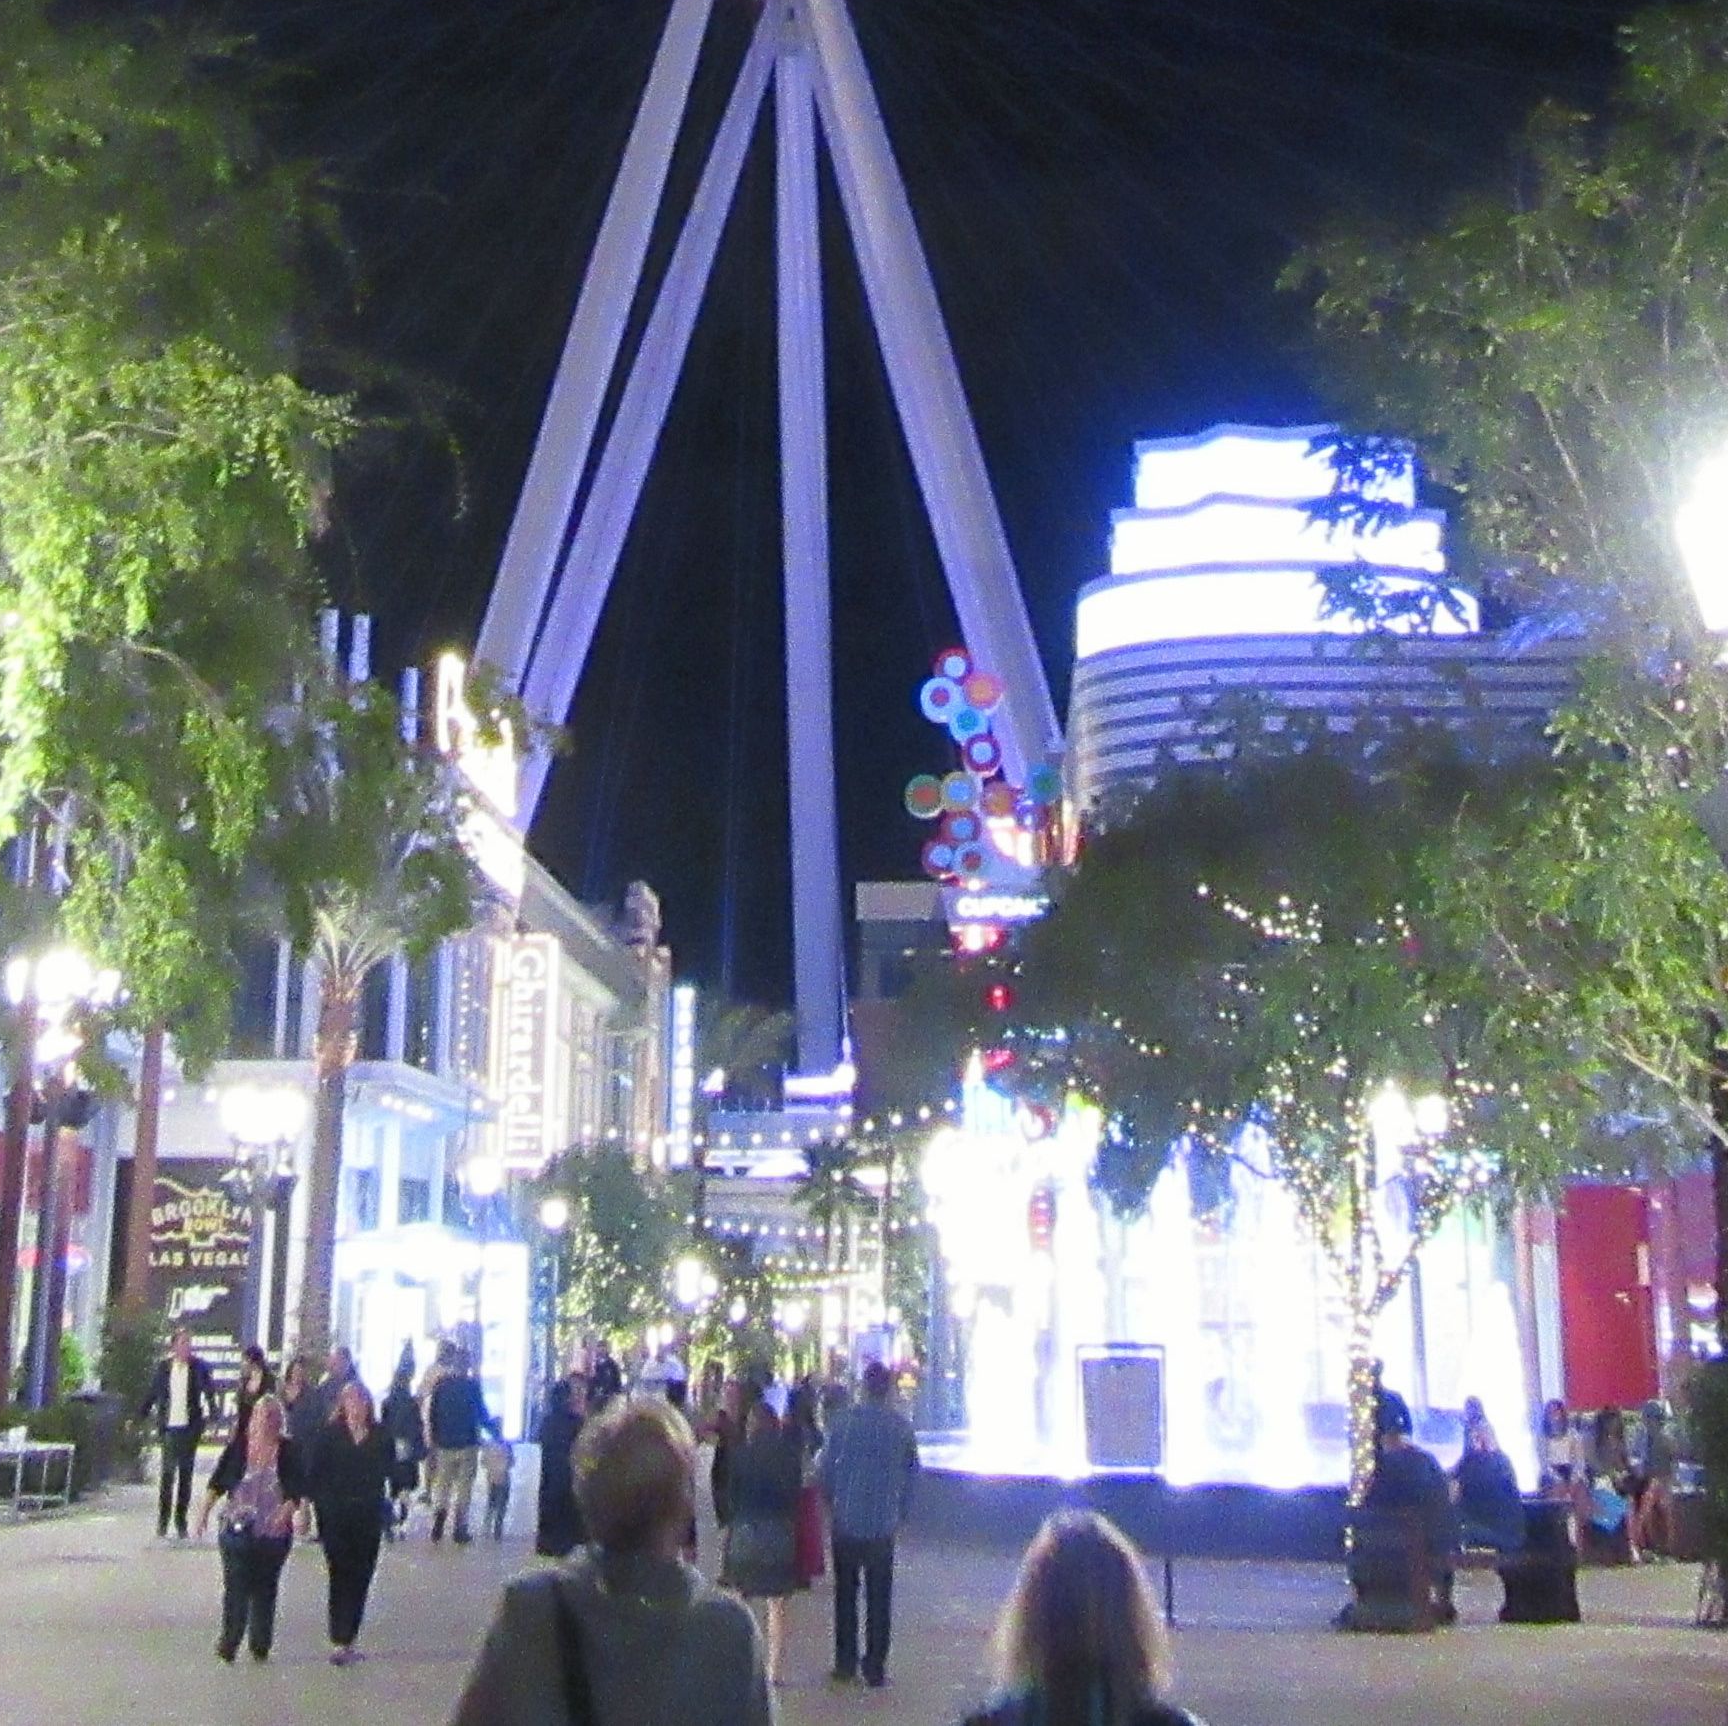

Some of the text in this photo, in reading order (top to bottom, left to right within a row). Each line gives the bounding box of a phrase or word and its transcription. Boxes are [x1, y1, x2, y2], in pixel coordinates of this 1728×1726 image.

[506, 947, 547, 1152] Ghirardelli
[183, 1217, 227, 1233] BOWL
[148, 1250, 185, 1267] LAS
